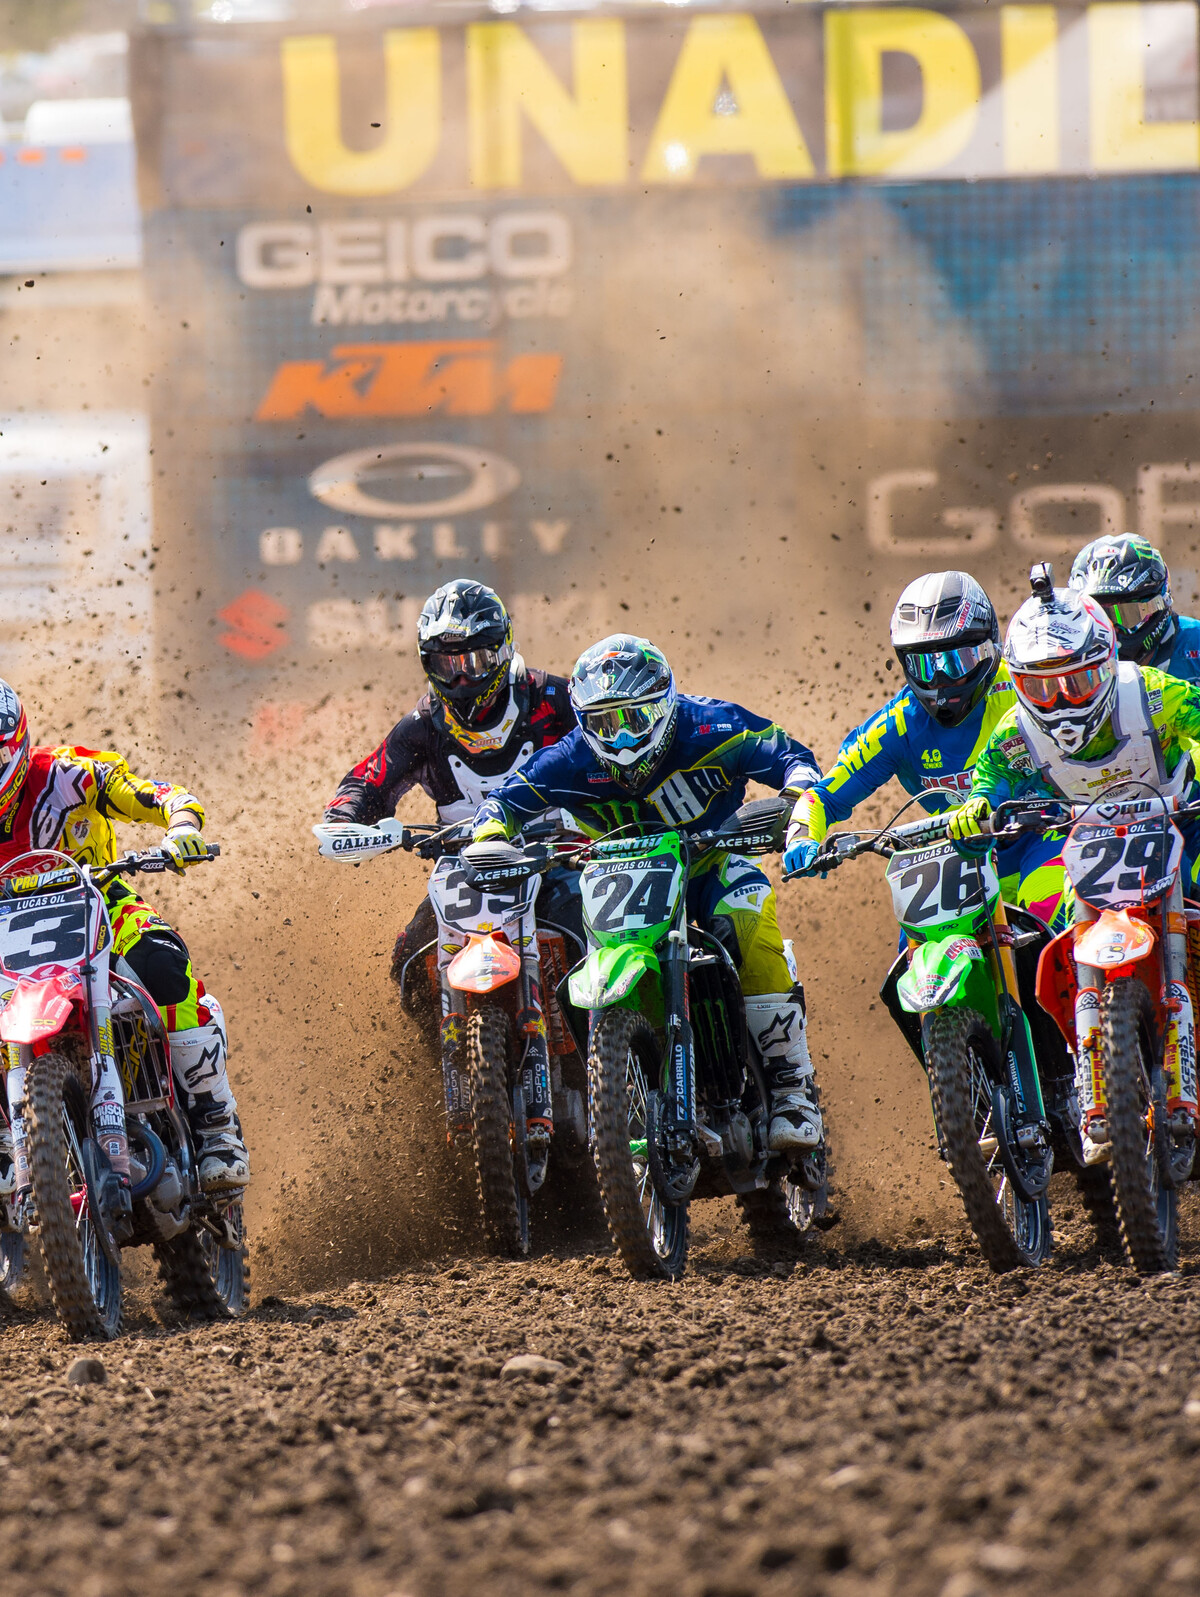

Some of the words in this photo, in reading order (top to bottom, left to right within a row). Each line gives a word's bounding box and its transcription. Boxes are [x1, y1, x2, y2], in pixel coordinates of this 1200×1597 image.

[282, 2, 1200, 194] UNADIL
[236, 212, 572, 290] GEICO
[256, 341, 562, 421] KTM
[259, 520, 571, 565] OAKLEY
[921, 748, 942, 763] 4.0
[4, 802, 19, 833] GEICO
[1129, 824, 1147, 833] OIL
[332, 834, 393, 851] GALFER
[597, 834, 662, 852] RENTHA
[715, 835, 774, 848] ACERBIS
[606, 862, 636, 874] LUCAS
[637, 860, 653, 869] OIL
[912, 848, 942, 865] LUCAS
[1074, 832, 1175, 899] 29
[473, 867, 531, 882] ACERBIS
[17, 897, 48, 910] LUCAS
[49, 894, 65, 905] OIL
[591, 871, 675, 933] 24
[732, 884, 764, 898] thor
[900, 854, 986, 924] 26
[3, 902, 88, 971] 3
[97, 925, 107, 951] GEICO
[675, 1044, 684, 1095] CARRILLO
[1008, 1051, 1022, 1092] CARRILLO
[1178, 1036, 1190, 1096] ACERBIS
[535, 1063, 543, 1104] GoPro
[93, 1104, 124, 1119] MUSCLE
[101, 1114, 124, 1127] MILK
